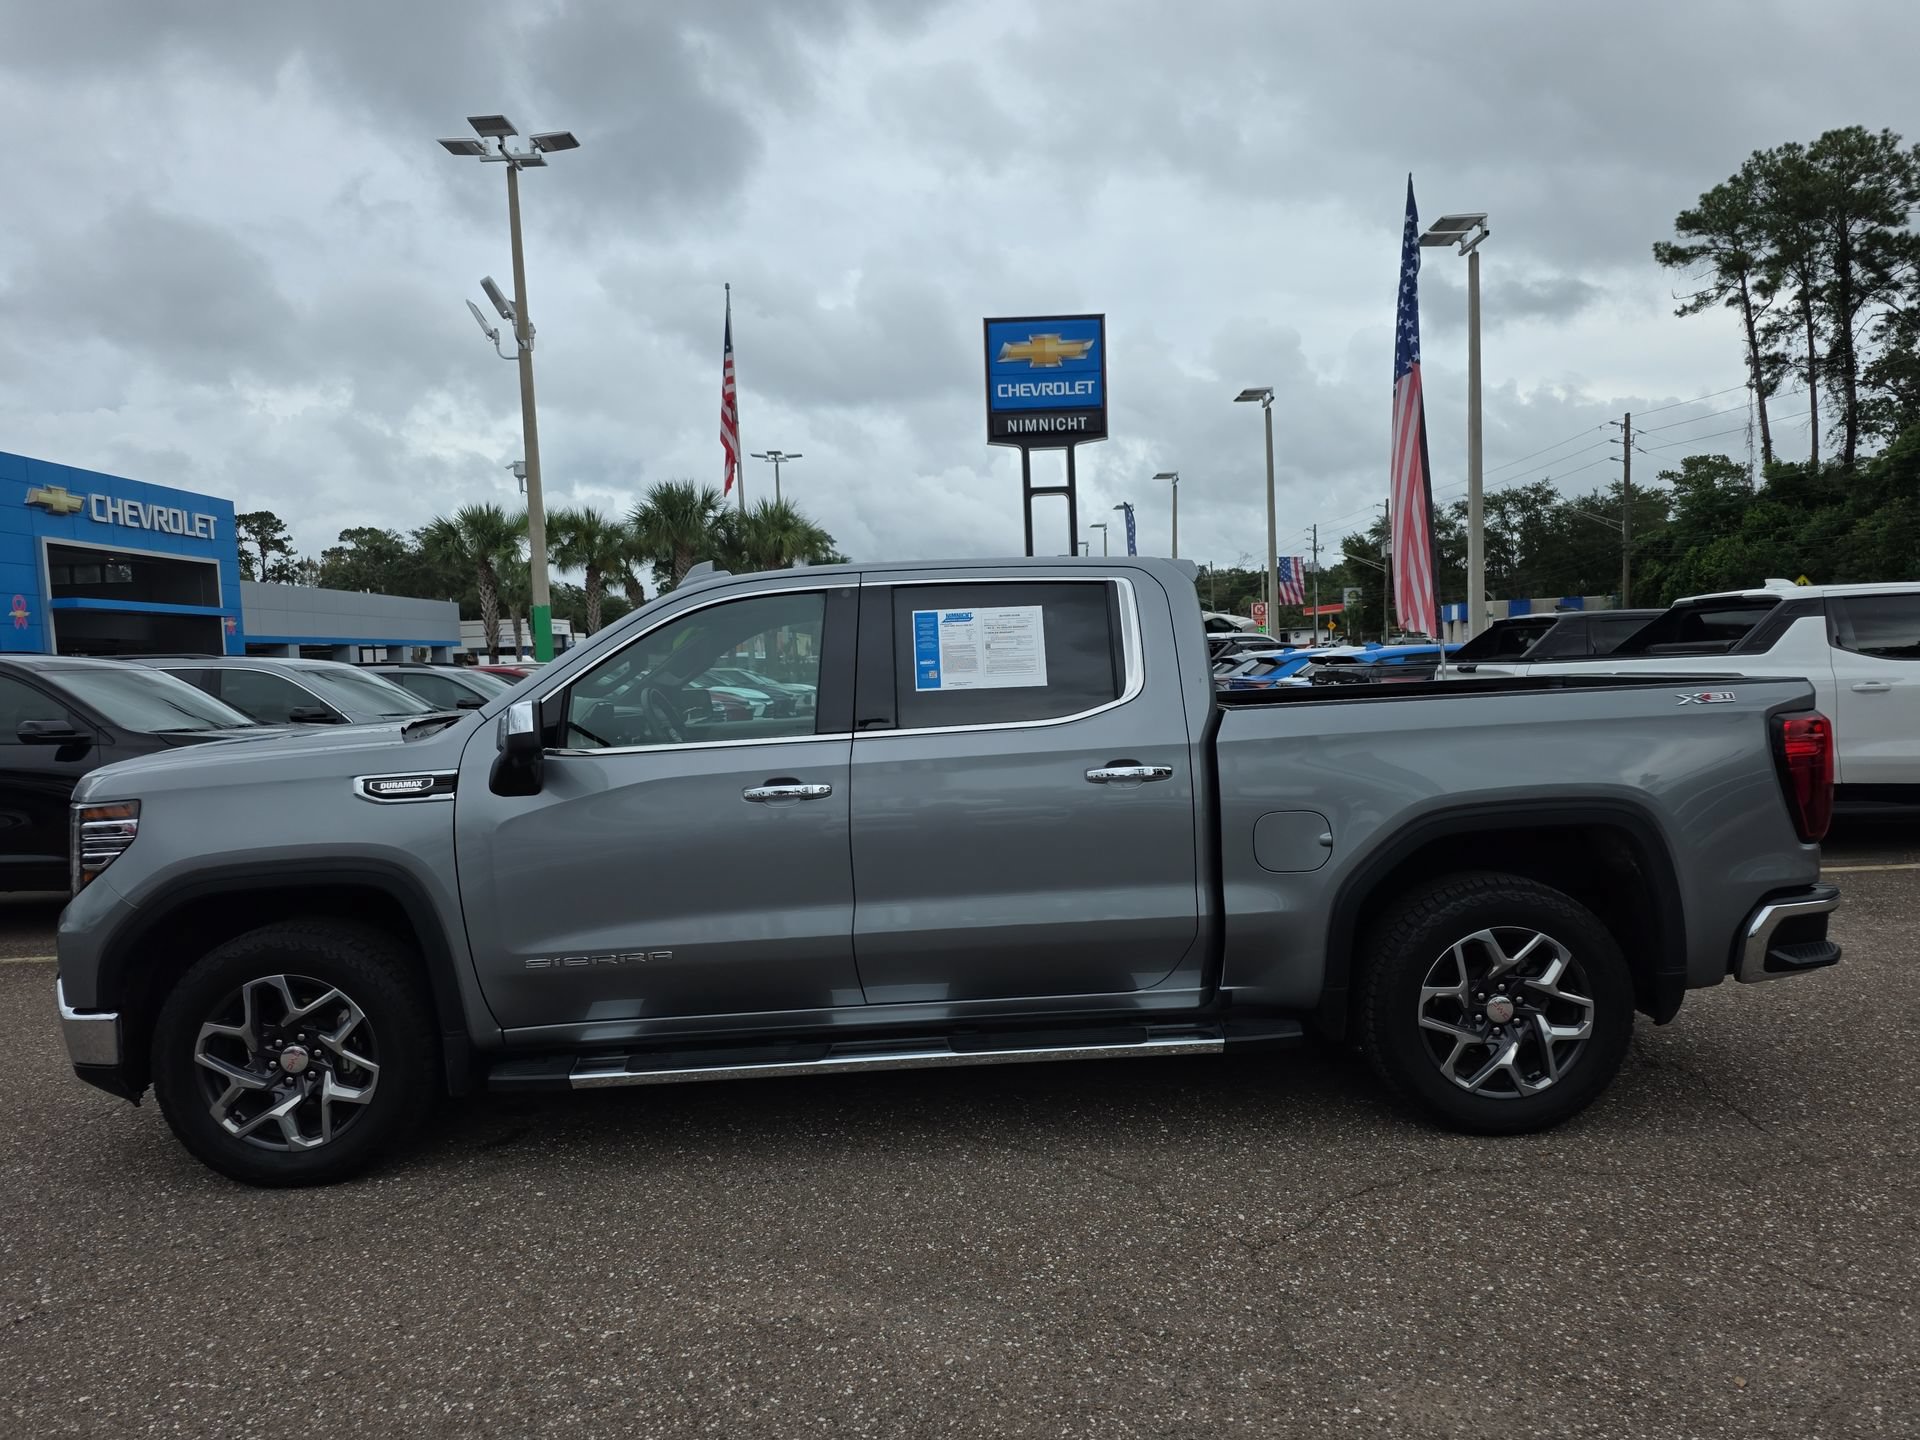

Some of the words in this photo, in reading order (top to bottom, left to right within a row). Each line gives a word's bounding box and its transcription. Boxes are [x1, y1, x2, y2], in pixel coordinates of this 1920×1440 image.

[998, 380, 1095, 398] CHEVROLET
[1007, 417, 1087, 433] NIMNICHT
[89, 493, 217, 539] CHEVROLET
[380, 780, 423, 789] DURAMAX
[525, 951, 673, 969] SIERRA
